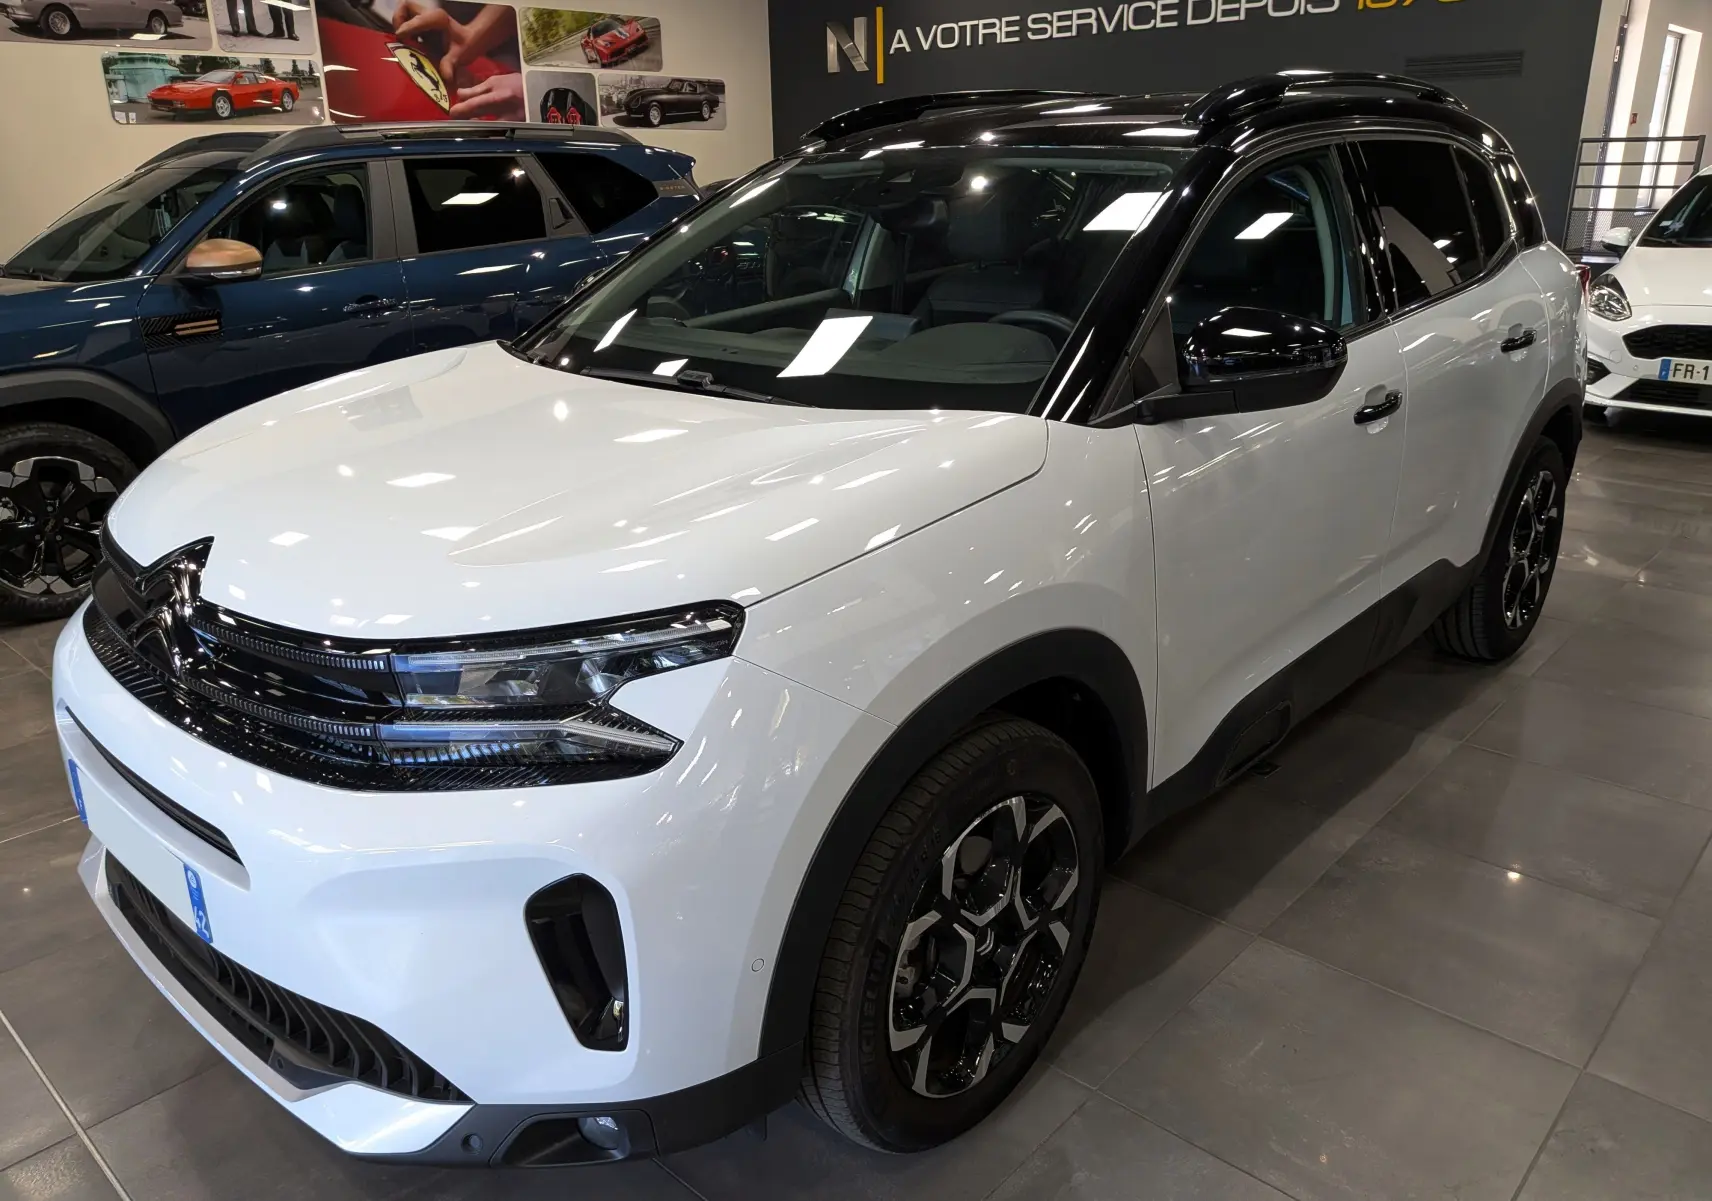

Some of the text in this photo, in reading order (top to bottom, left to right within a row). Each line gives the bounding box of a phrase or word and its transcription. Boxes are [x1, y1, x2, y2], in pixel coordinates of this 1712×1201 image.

[889, 28, 912, 54] A
[916, 15, 1020, 51] VOTRE
[1027, 0, 1180, 40] SERVICE
